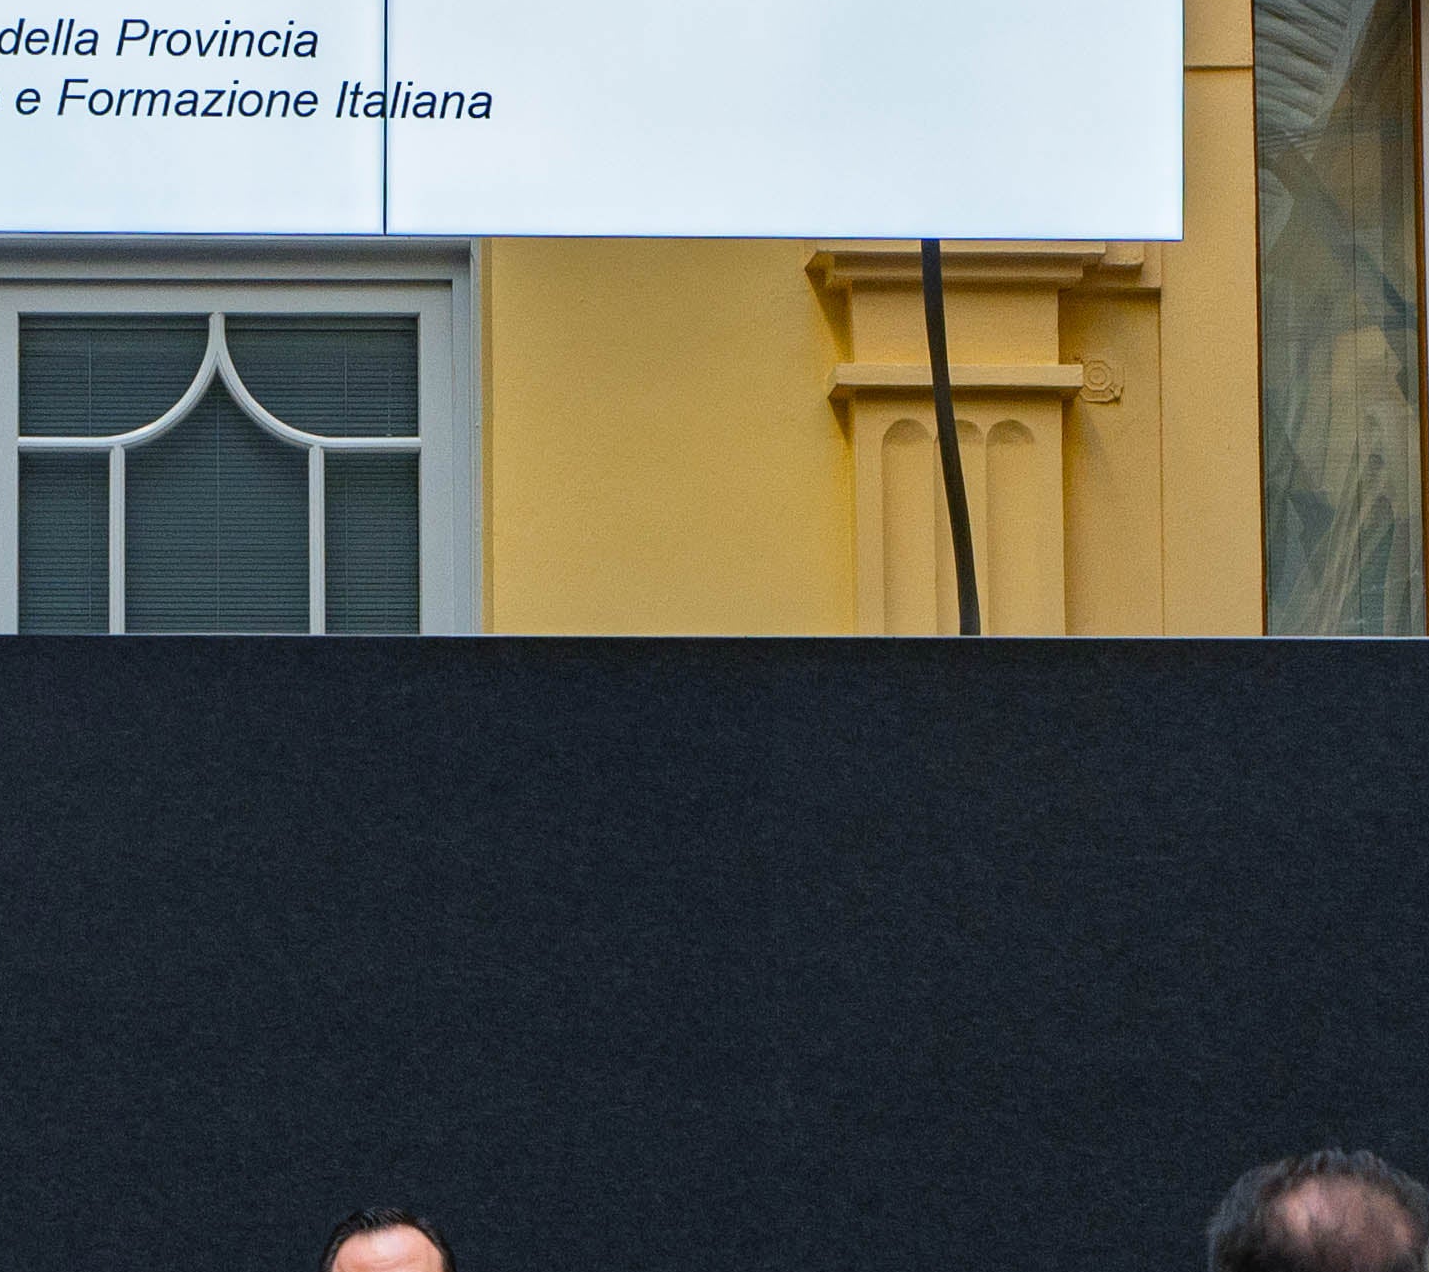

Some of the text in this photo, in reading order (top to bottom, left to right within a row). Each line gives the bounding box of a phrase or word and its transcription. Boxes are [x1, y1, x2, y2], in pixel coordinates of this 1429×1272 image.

[115, 18, 319, 60] Provincia
[14, 87, 42, 117] e
[56, 78, 319, 119] Formazione
[334, 79, 493, 120] Italiana
